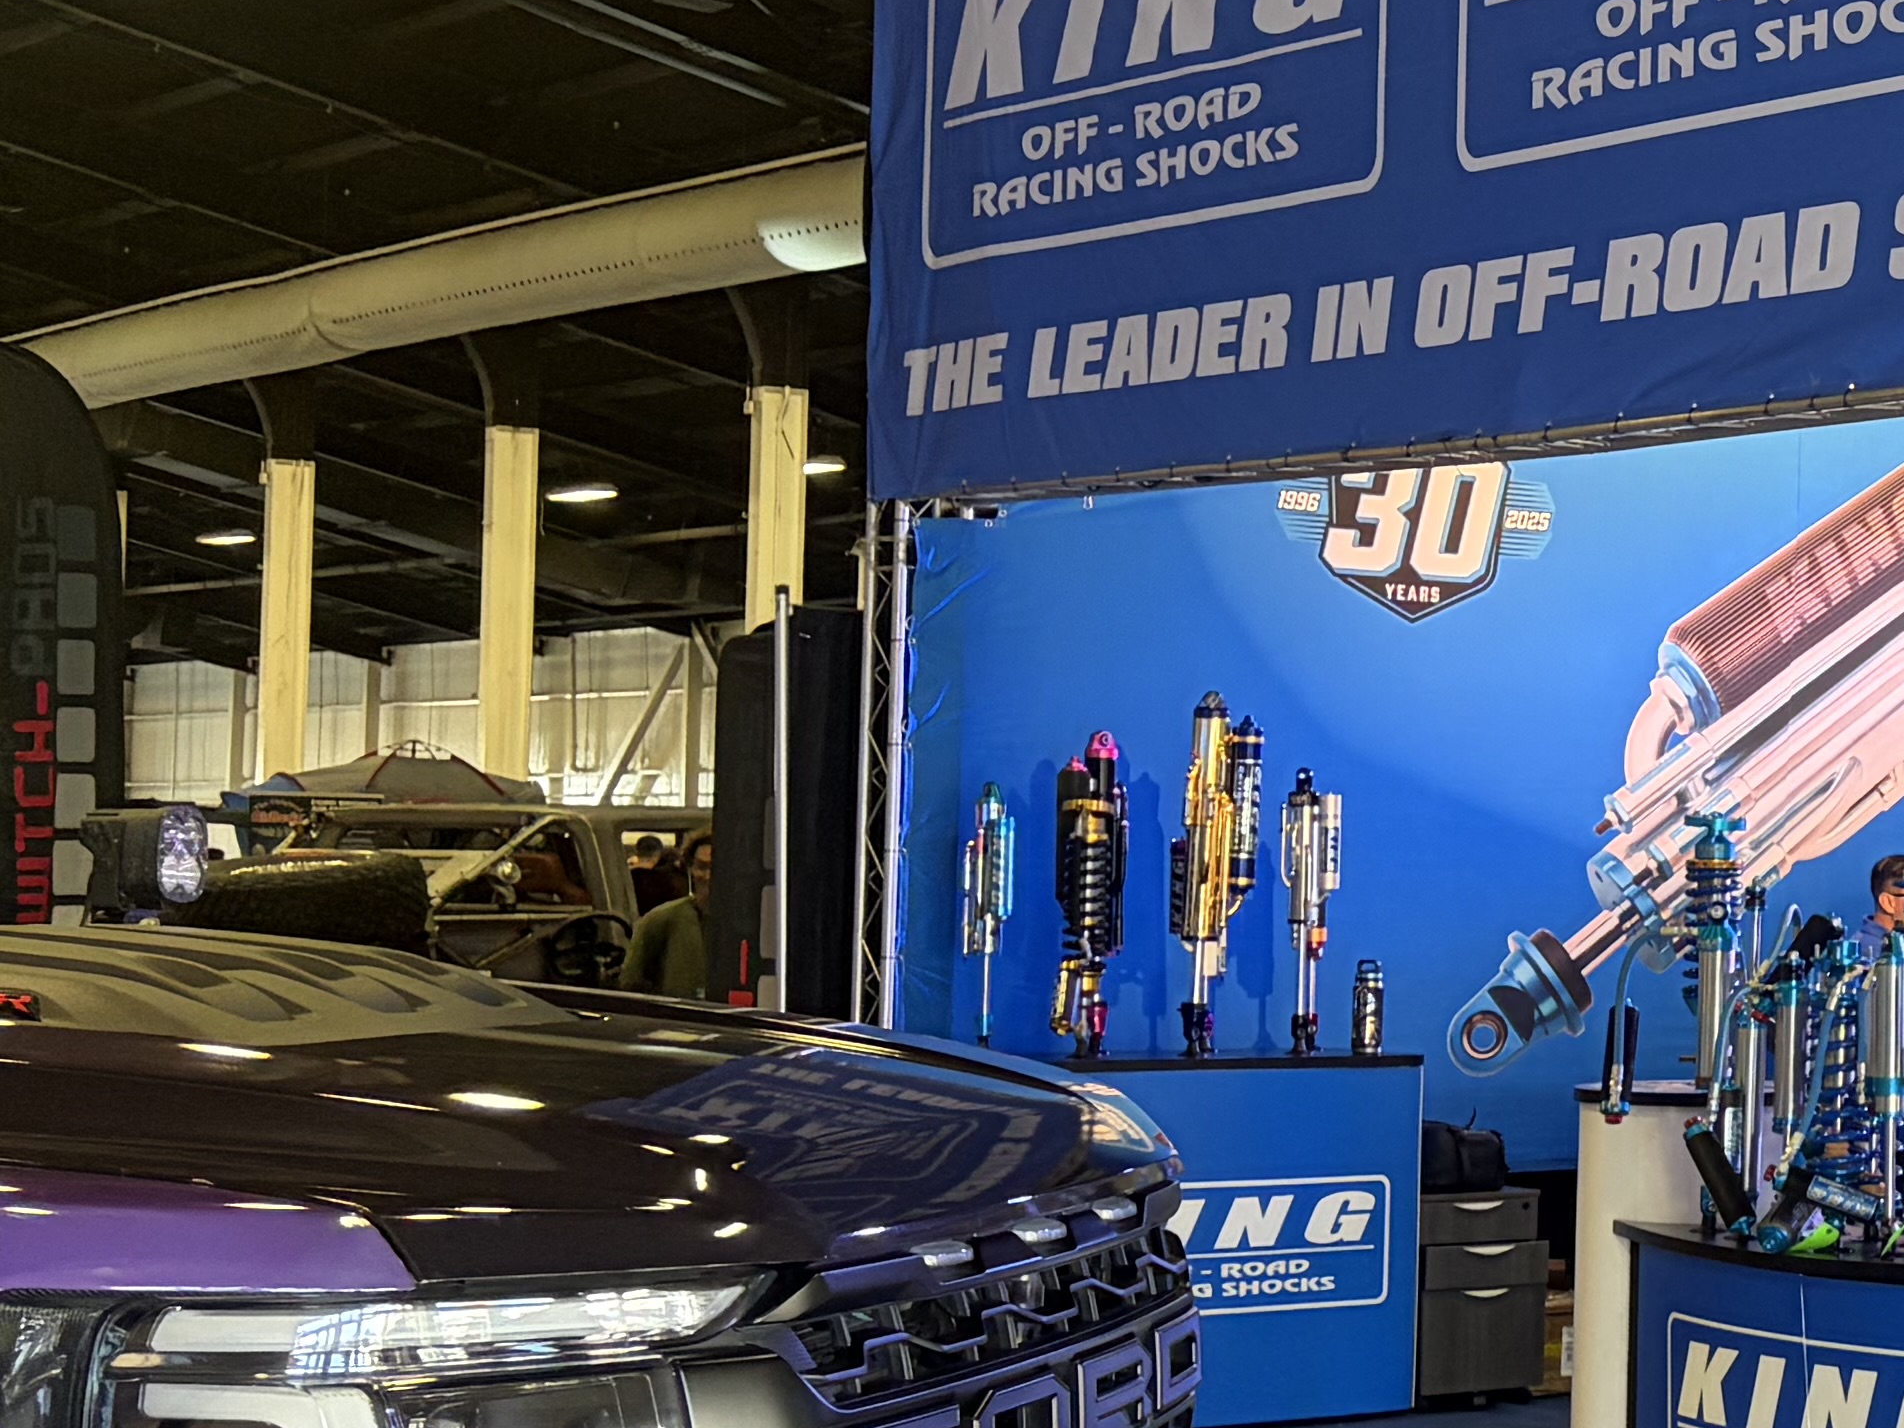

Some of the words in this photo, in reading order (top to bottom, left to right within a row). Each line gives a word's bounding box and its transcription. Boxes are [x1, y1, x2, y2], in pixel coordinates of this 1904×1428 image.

[1531, 28, 1738, 110] RACING
[971, 161, 1124, 217] RACING
[1134, 122, 1301, 189] SHOCKS
[904, 334, 1009, 418] THE
[1026, 293, 1293, 399] LEADER
[1310, 276, 1396, 364] IN
[1414, 200, 1862, 349] OFF-ROAD
[1277, 489, 1322, 513] 1996
[1321, 460, 1512, 582] 30
[1503, 508, 1553, 532] 2025
[1384, 582, 1441, 604] YEARS
[1171, 1190, 1376, 1249] ING
[1220, 1258, 1310, 1278] ROAD
[1221, 1275, 1336, 1298] SHOCKS
